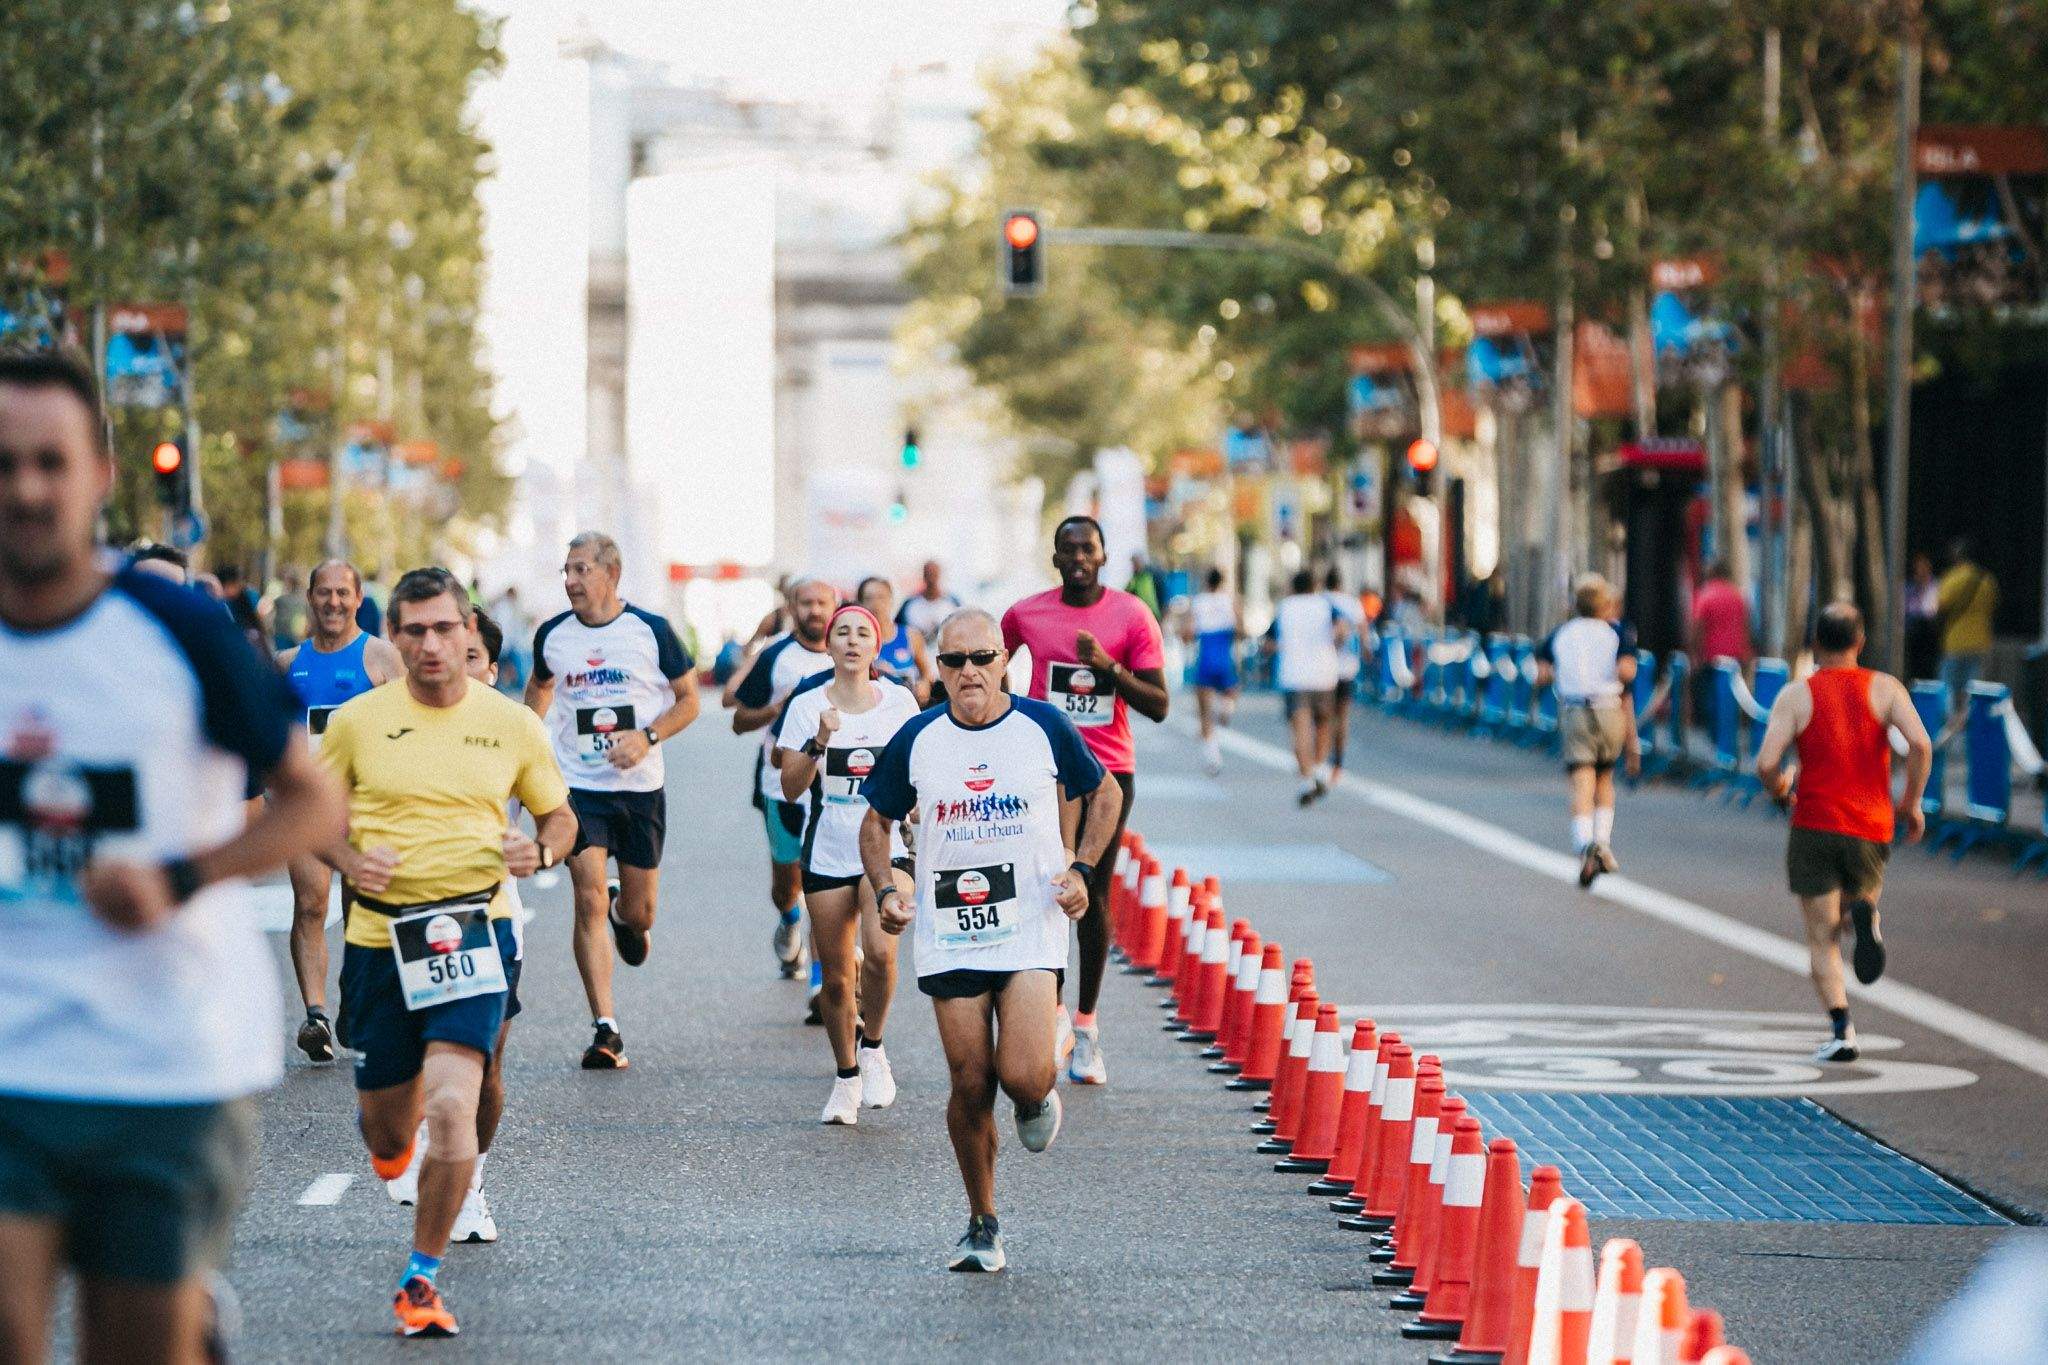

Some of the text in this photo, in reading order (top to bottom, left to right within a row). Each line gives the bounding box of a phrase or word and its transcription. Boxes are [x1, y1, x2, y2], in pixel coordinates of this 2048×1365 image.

[1066, 694, 1097, 713] 532
[464, 735, 500, 748] RFEA
[946, 822, 1023, 842] Milla Urbana
[957, 905, 1000, 931] 554
[428, 954, 475, 984] 560
